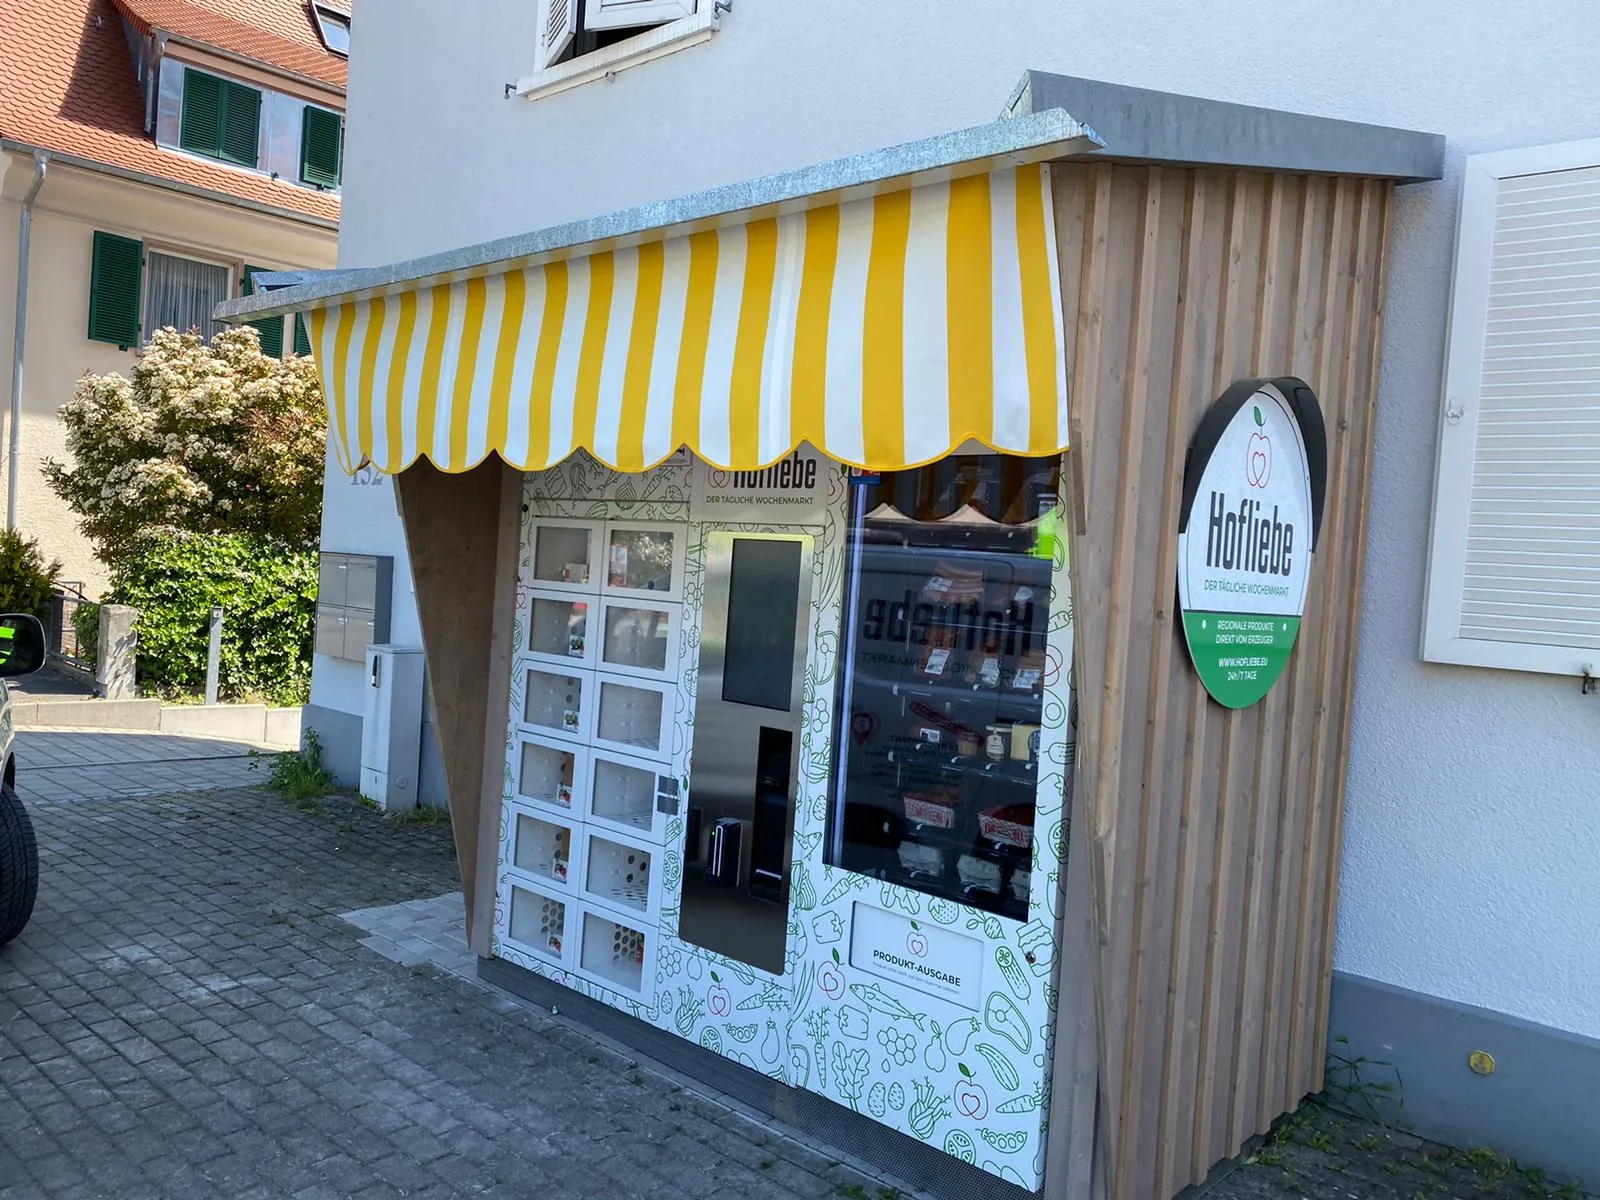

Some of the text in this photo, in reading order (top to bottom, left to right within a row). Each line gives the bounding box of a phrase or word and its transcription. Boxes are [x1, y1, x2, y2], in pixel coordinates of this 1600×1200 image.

[706, 494, 814, 505] DER TÄGLICHE WOCHENMARKT
[1206, 490, 1294, 577] Hofliebe
[1204, 578, 1290, 597] DER TÄGLICHE WOCHENMARKT
[1217, 620, 1274, 632] REGIONALE PRODUKTE
[1216, 634, 1235, 644] DIREKT
[1248, 635, 1274, 645] ERZEUGER
[873, 949, 962, 987] PRODUKT-AUSGABE
